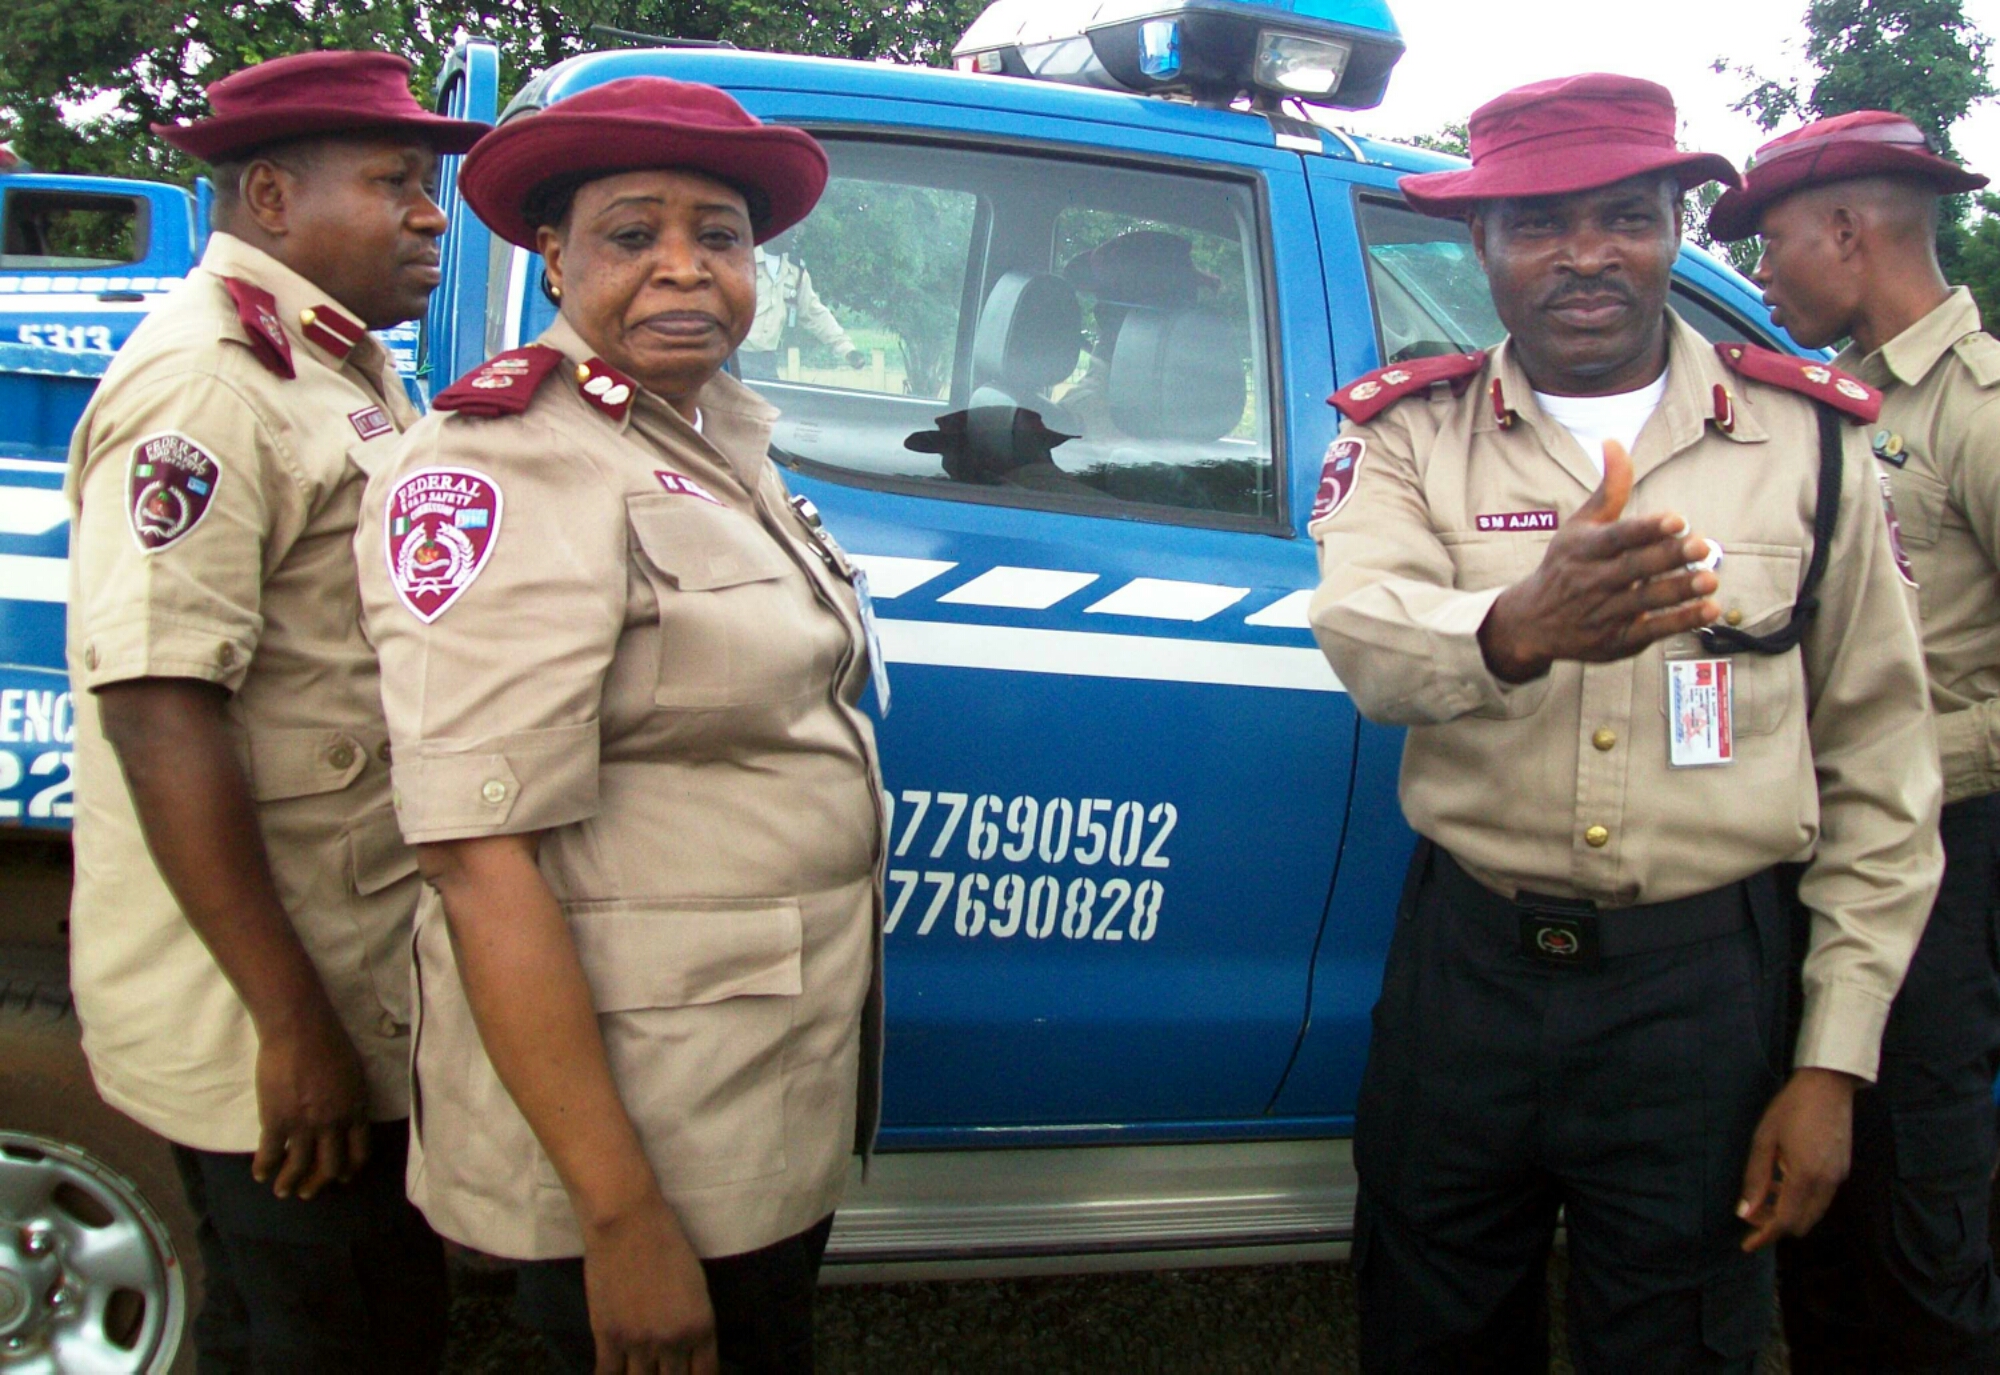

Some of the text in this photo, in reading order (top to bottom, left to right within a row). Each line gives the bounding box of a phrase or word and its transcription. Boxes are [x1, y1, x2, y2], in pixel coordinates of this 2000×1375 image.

[18, 323, 112, 352] 5313
[145, 436, 208, 468] FEDERAL
[397, 475, 482, 503] FEDERAL
[428, 491, 473, 507] SAFETY
[1509, 514, 1554, 528] AJAYI
